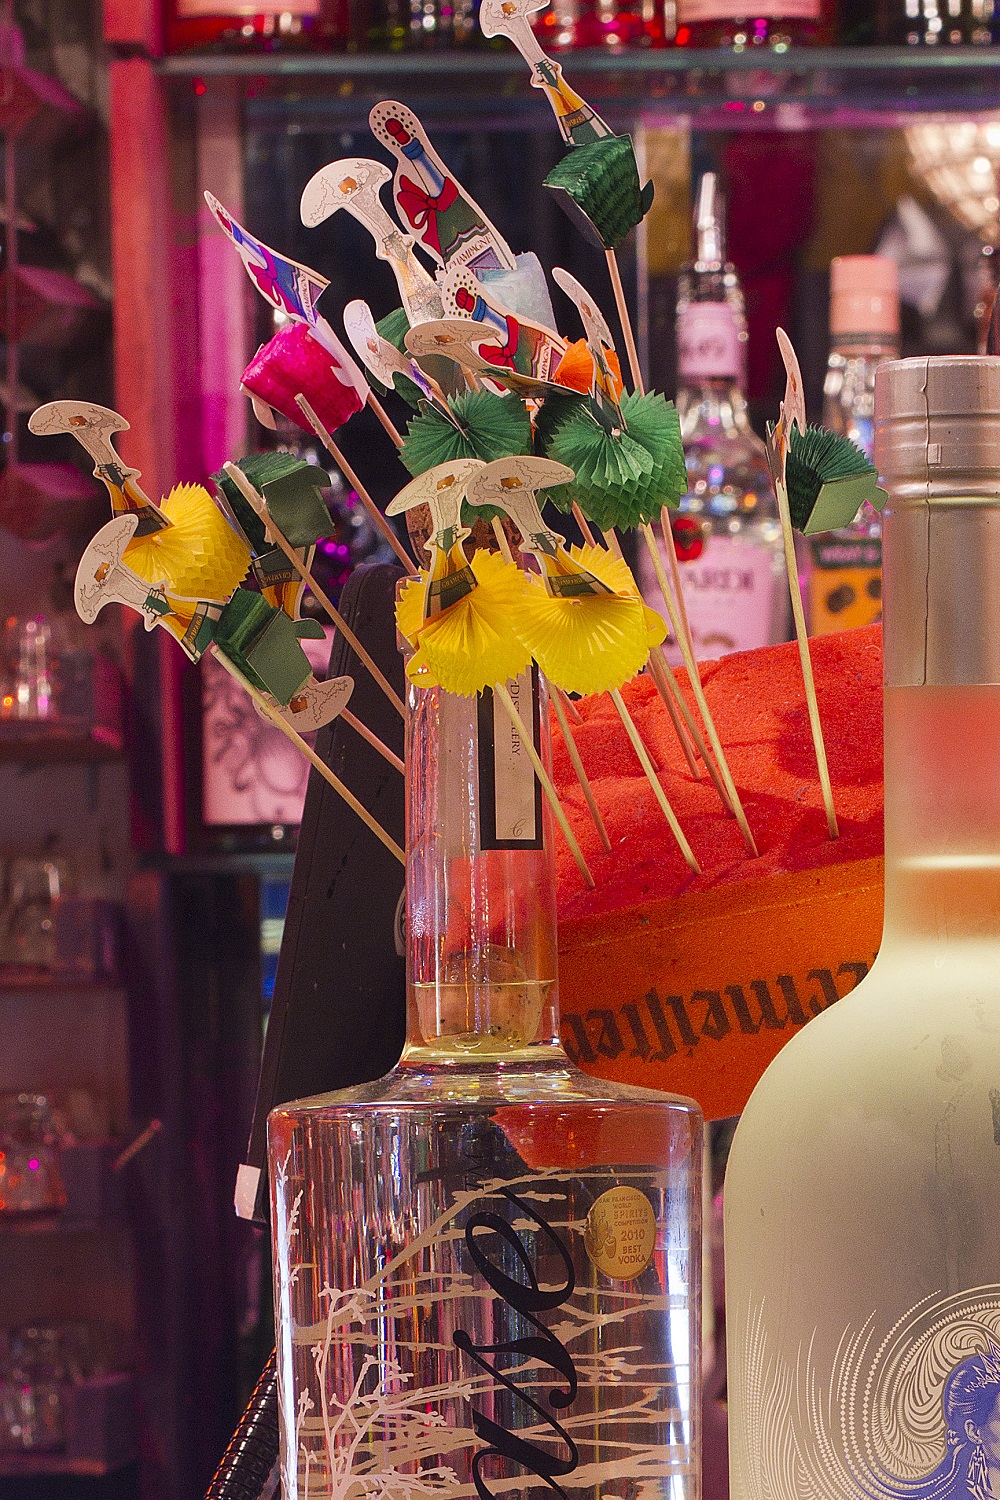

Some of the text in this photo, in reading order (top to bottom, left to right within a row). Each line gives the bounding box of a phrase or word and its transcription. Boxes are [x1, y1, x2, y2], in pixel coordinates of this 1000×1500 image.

[620, 1229, 646, 1242] 2010
[622, 1244, 642, 1255] BEST
[617, 1255, 647, 1265] VODKA
